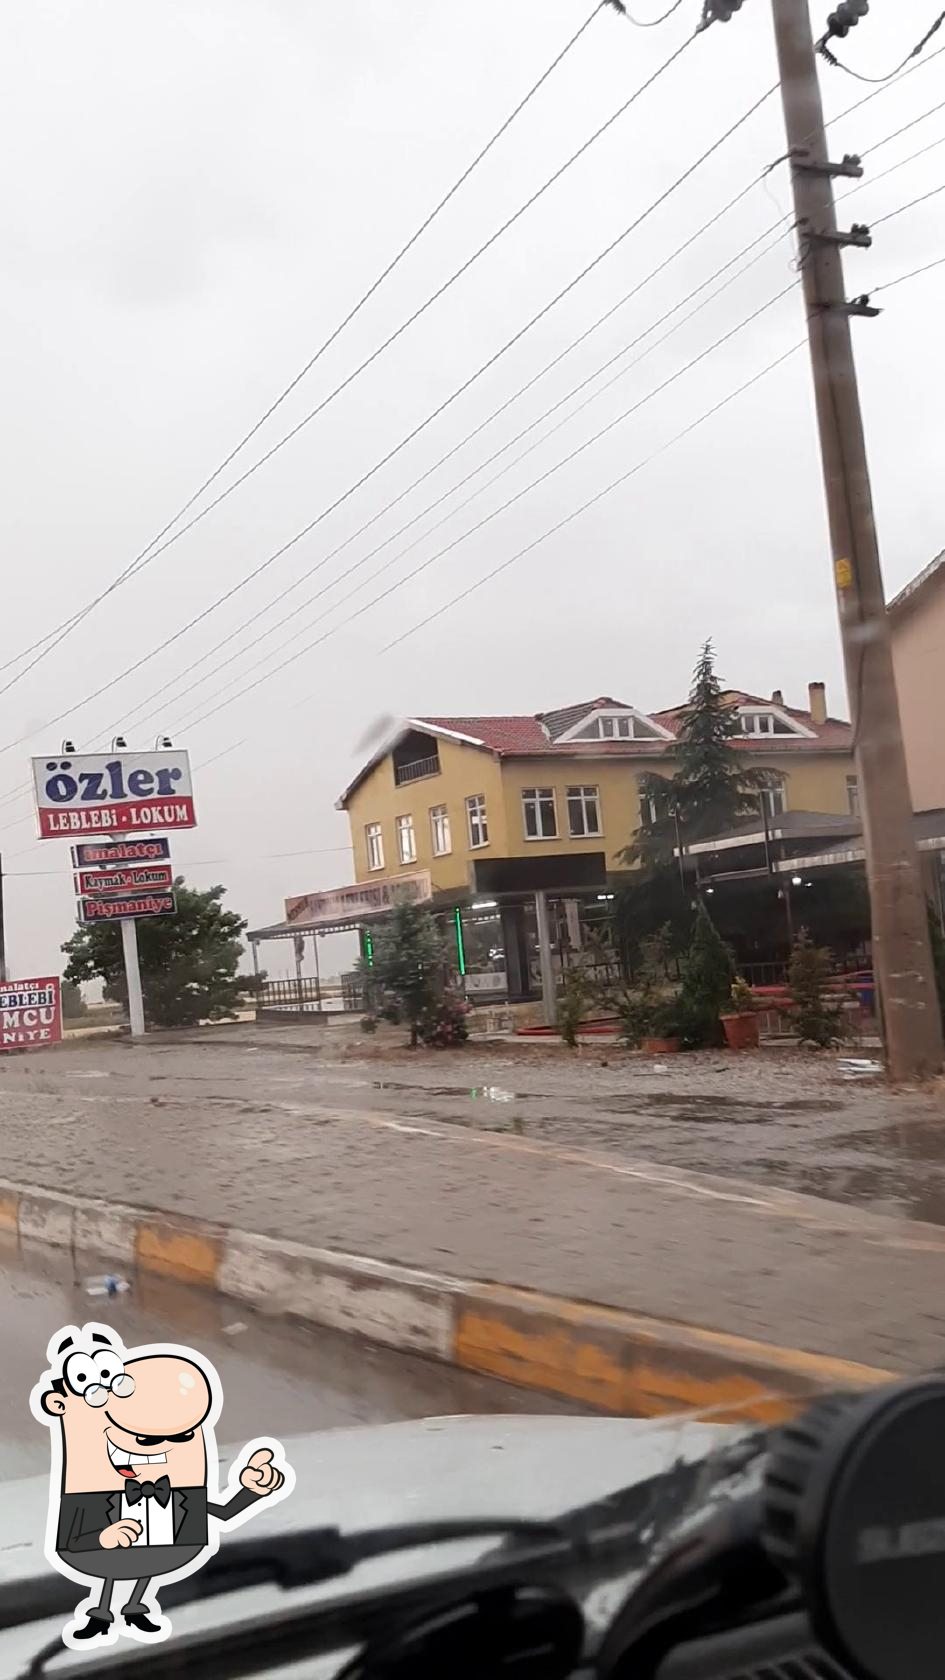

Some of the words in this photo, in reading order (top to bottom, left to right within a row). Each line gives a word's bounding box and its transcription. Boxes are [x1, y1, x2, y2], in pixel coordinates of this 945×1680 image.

[45, 760, 182, 803] özler
[129, 804, 188, 825] LOKUM
[84, 872, 127, 891] Kaymak
[132, 869, 168, 885] Lokum
[86, 896, 172, 917] Pişmaniye
[2, 1006, 56, 1030] MCU
